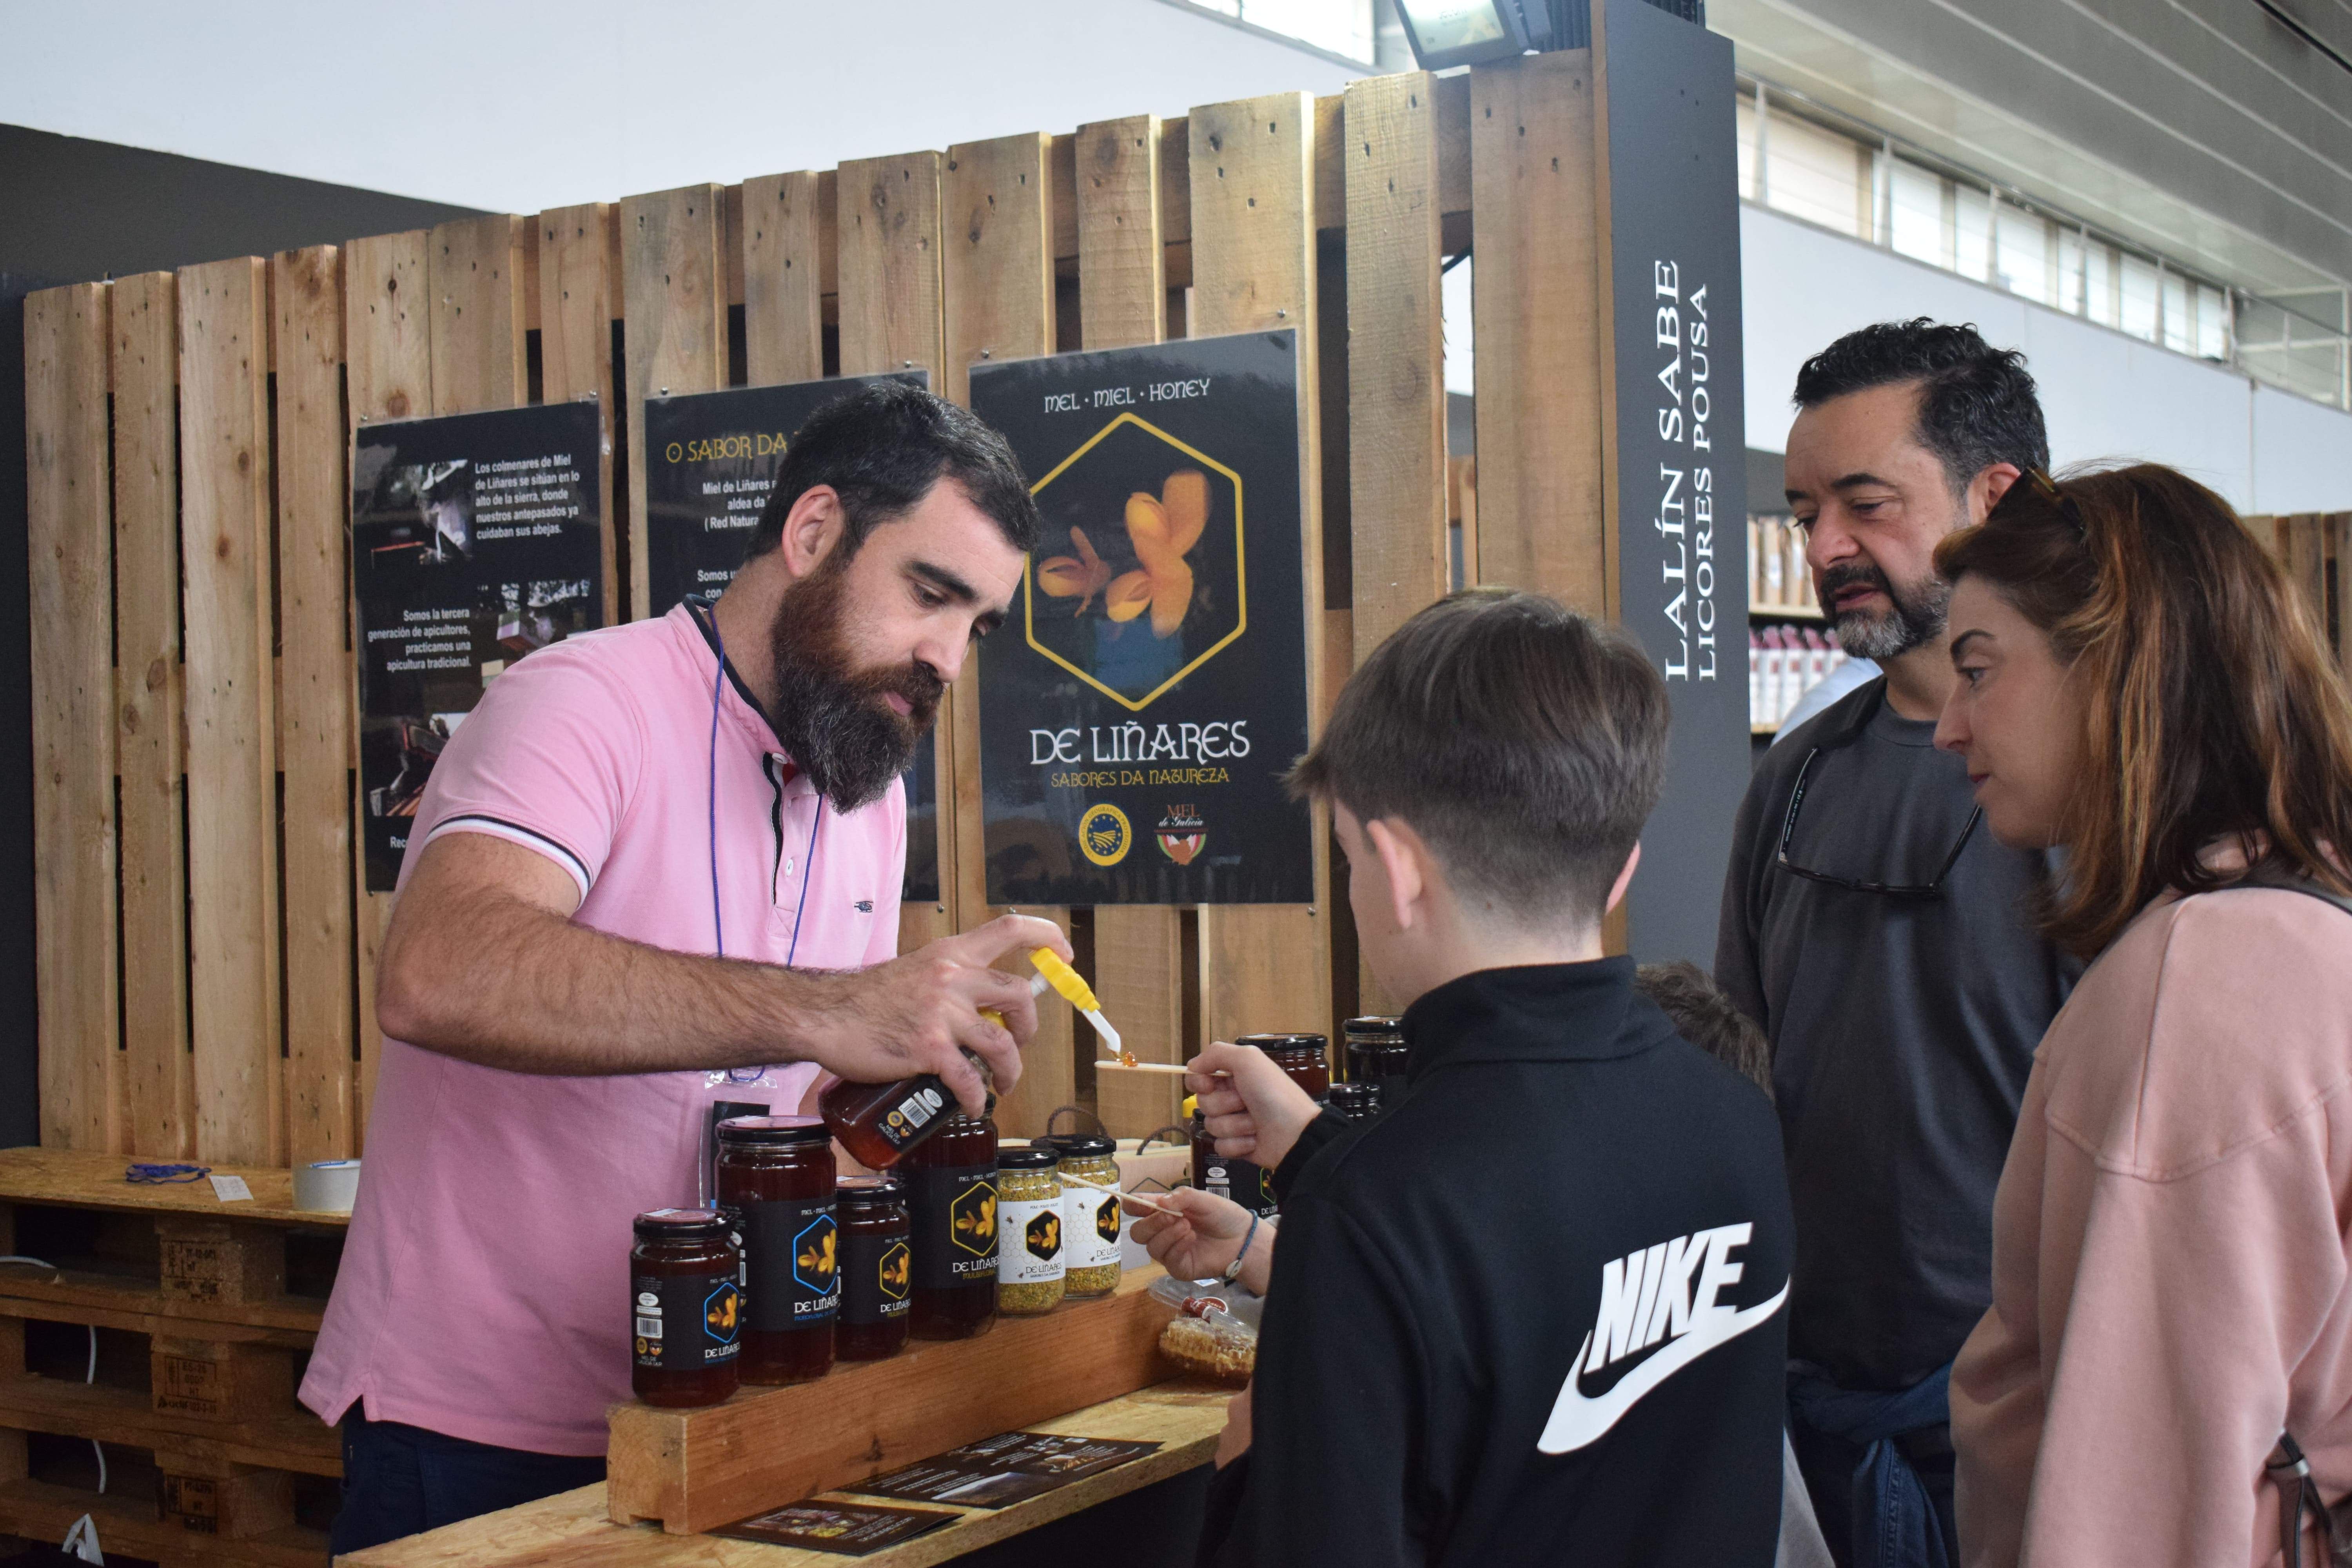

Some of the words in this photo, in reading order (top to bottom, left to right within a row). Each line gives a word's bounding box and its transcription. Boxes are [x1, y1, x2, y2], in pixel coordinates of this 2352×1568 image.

[1655, 260, 1684, 443] SABE
[1689, 284, 1711, 453] POUSA
[1044, 394, 1080, 413] MEL
[1094, 387, 1135, 408] MIEL
[1149, 378, 1210, 401] HONEY
[666, 443, 682, 463] O
[687, 436, 753, 461] SABOR
[757, 432, 788, 455] DA
[475, 462, 490, 474] Los
[492, 460, 539, 472] colmenares
[541, 456, 552, 468] de
[553, 454, 571, 466] Miel
[475, 479, 486, 490] de
[487, 477, 517, 489] Liñares
[519, 477, 529, 486] se
[531, 472, 557, 486] sitúan
[559, 473, 570, 483] en
[571, 470, 580, 482] lo
[703, 481, 721, 494] Miel
[723, 481, 734, 494] de
[736, 479, 769, 492] Liñares
[475, 494, 490, 507] alto
[492, 493, 503, 505] de
[505, 493, 512, 505] la
[514, 492, 541, 503] sierra,
[542, 488, 568, 501] donde
[727, 497, 752, 510] aldea
[754, 495, 765, 508] da
[476, 510, 512, 523] nuestros
[514, 505, 566, 521] antepasados
[568, 506, 579, 519] ya
[710, 515, 728, 529] Red
[477, 526, 514, 540] cuidaban
[515, 526, 531, 537] sus
[532, 523, 563, 537] abejas.
[697, 569, 728, 582] Somos
[1655, 462, 1689, 682] LALÍN
[1694, 467, 1716, 681] LICORES
[705, 588, 722, 599] con
[403, 610, 430, 622] Somos
[432, 608, 440, 620] la
[441, 608, 470, 619] tercera
[368, 626, 411, 643] generación
[412, 626, 422, 637] de
[424, 624, 470, 639] apicultores,
[405, 641, 454, 656] practicamos
[456, 641, 471, 651] una
[387, 658, 426, 673] apicultura
[427, 655, 472, 669] tradicional.
[1029, 728, 1081, 765] DE
[1090, 720, 1251, 765] LIÑARES
[1051, 771, 1116, 788] SABORES
[1121, 770, 1145, 785] DA
[1149, 768, 1230, 786] NATUREZA
[1167, 804, 1201, 817] MEL
[1158, 817, 1169, 827] de
[390, 836, 407, 848] Rec
[1096, 1249, 1106, 1258] DE
[953, 1262, 969, 1272] DE
[1583, 1221, 1753, 1374] NIKE
[794, 1301, 811, 1313] DE
[880, 1304, 891, 1313] DE
[705, 1349, 717, 1358] DE
